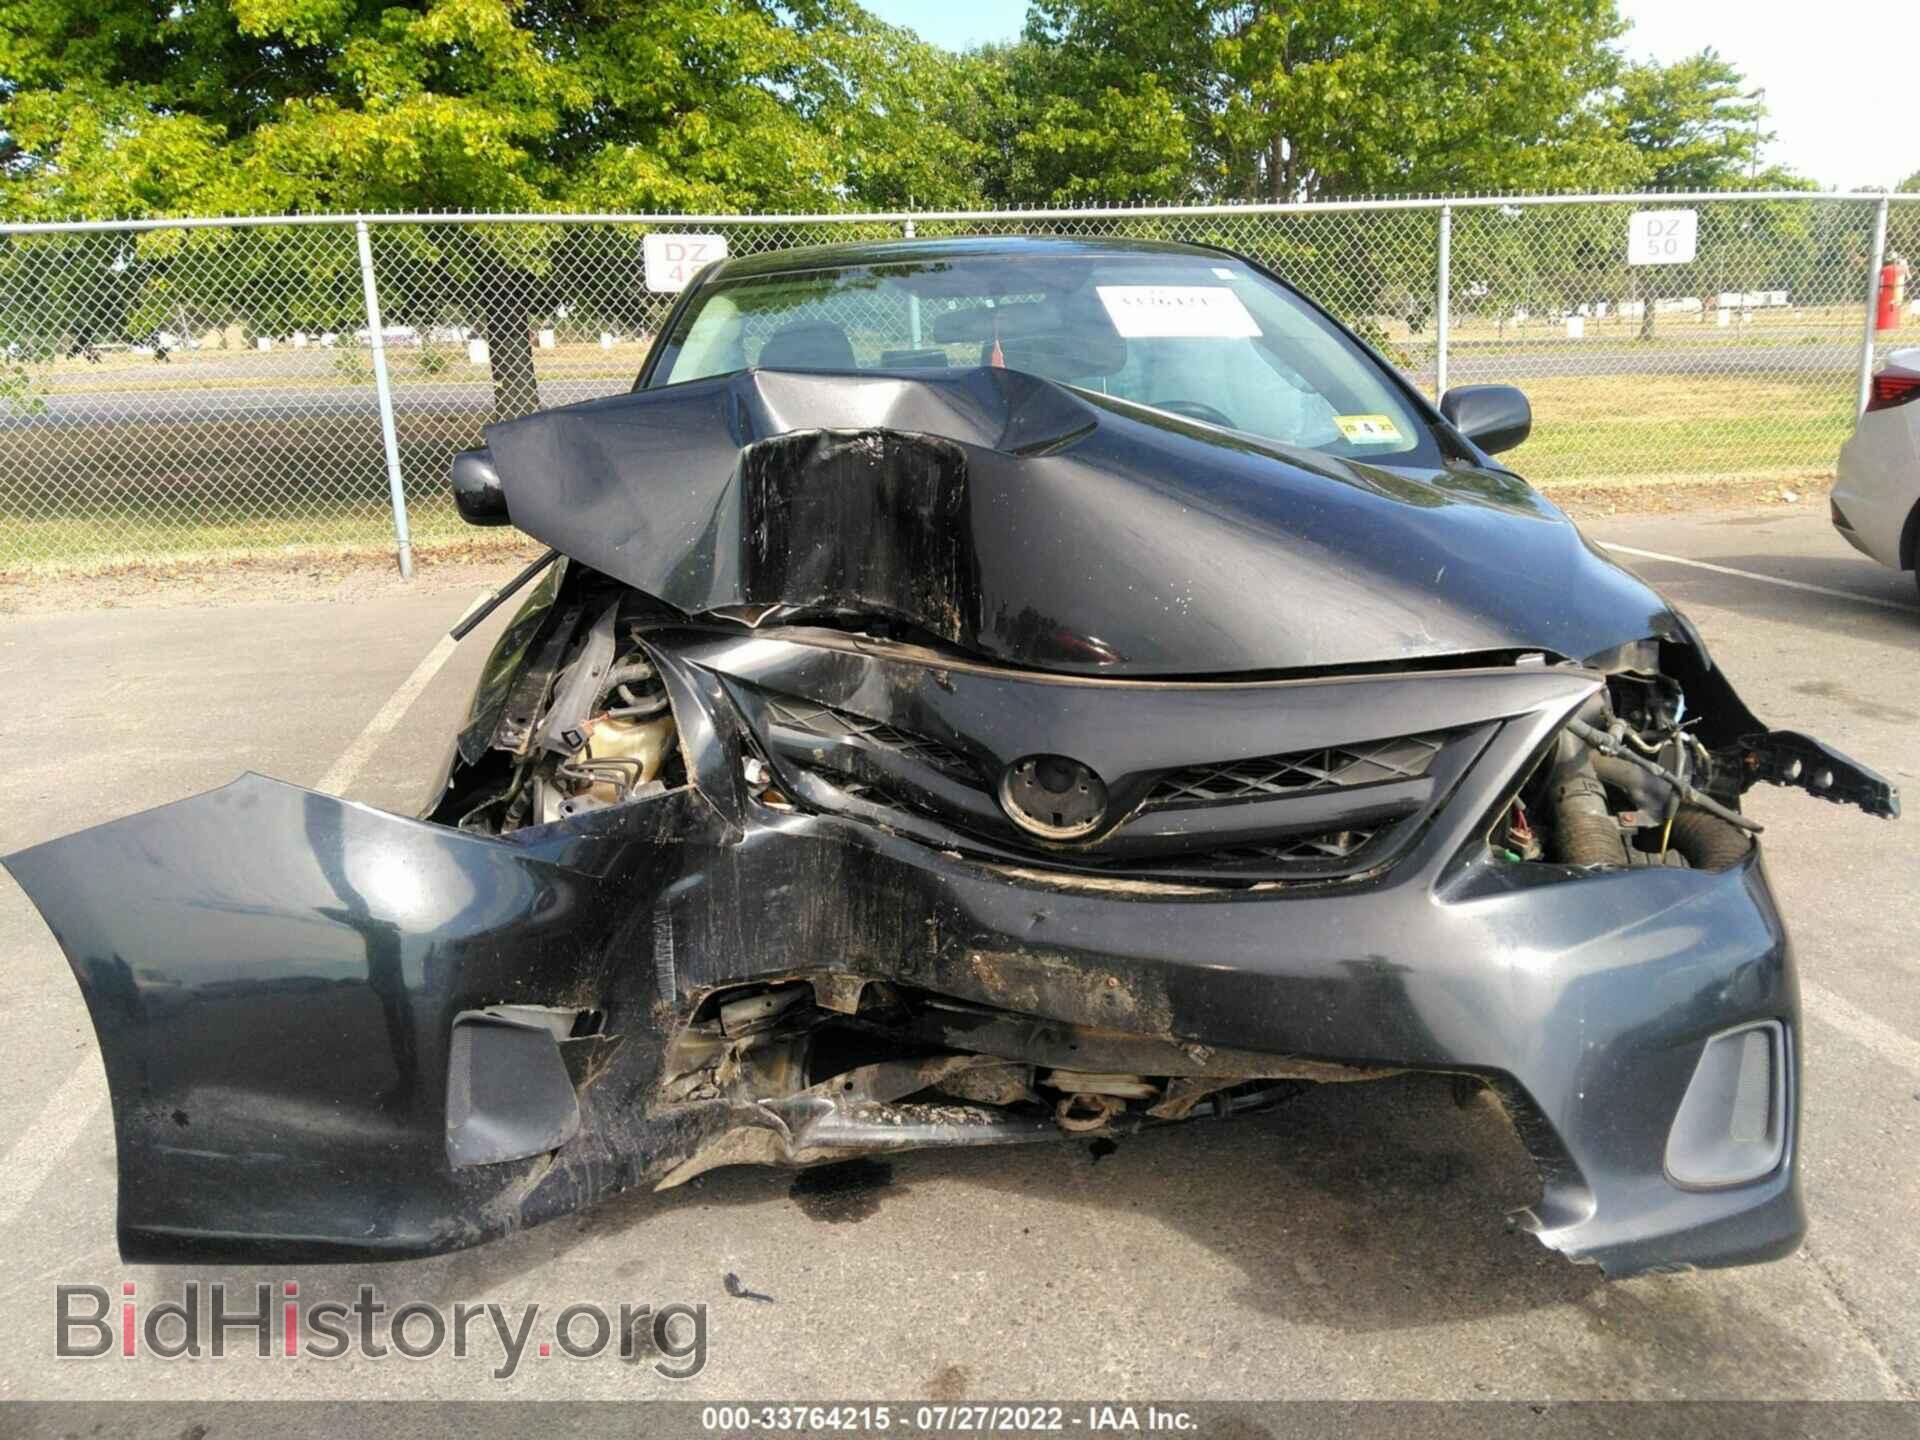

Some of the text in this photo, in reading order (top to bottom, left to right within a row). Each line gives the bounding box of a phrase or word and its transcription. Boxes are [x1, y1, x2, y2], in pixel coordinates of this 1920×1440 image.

[1647, 219, 1681, 237] DZ
[665, 243, 709, 262] DZ
[1647, 239, 1678, 256] 50
